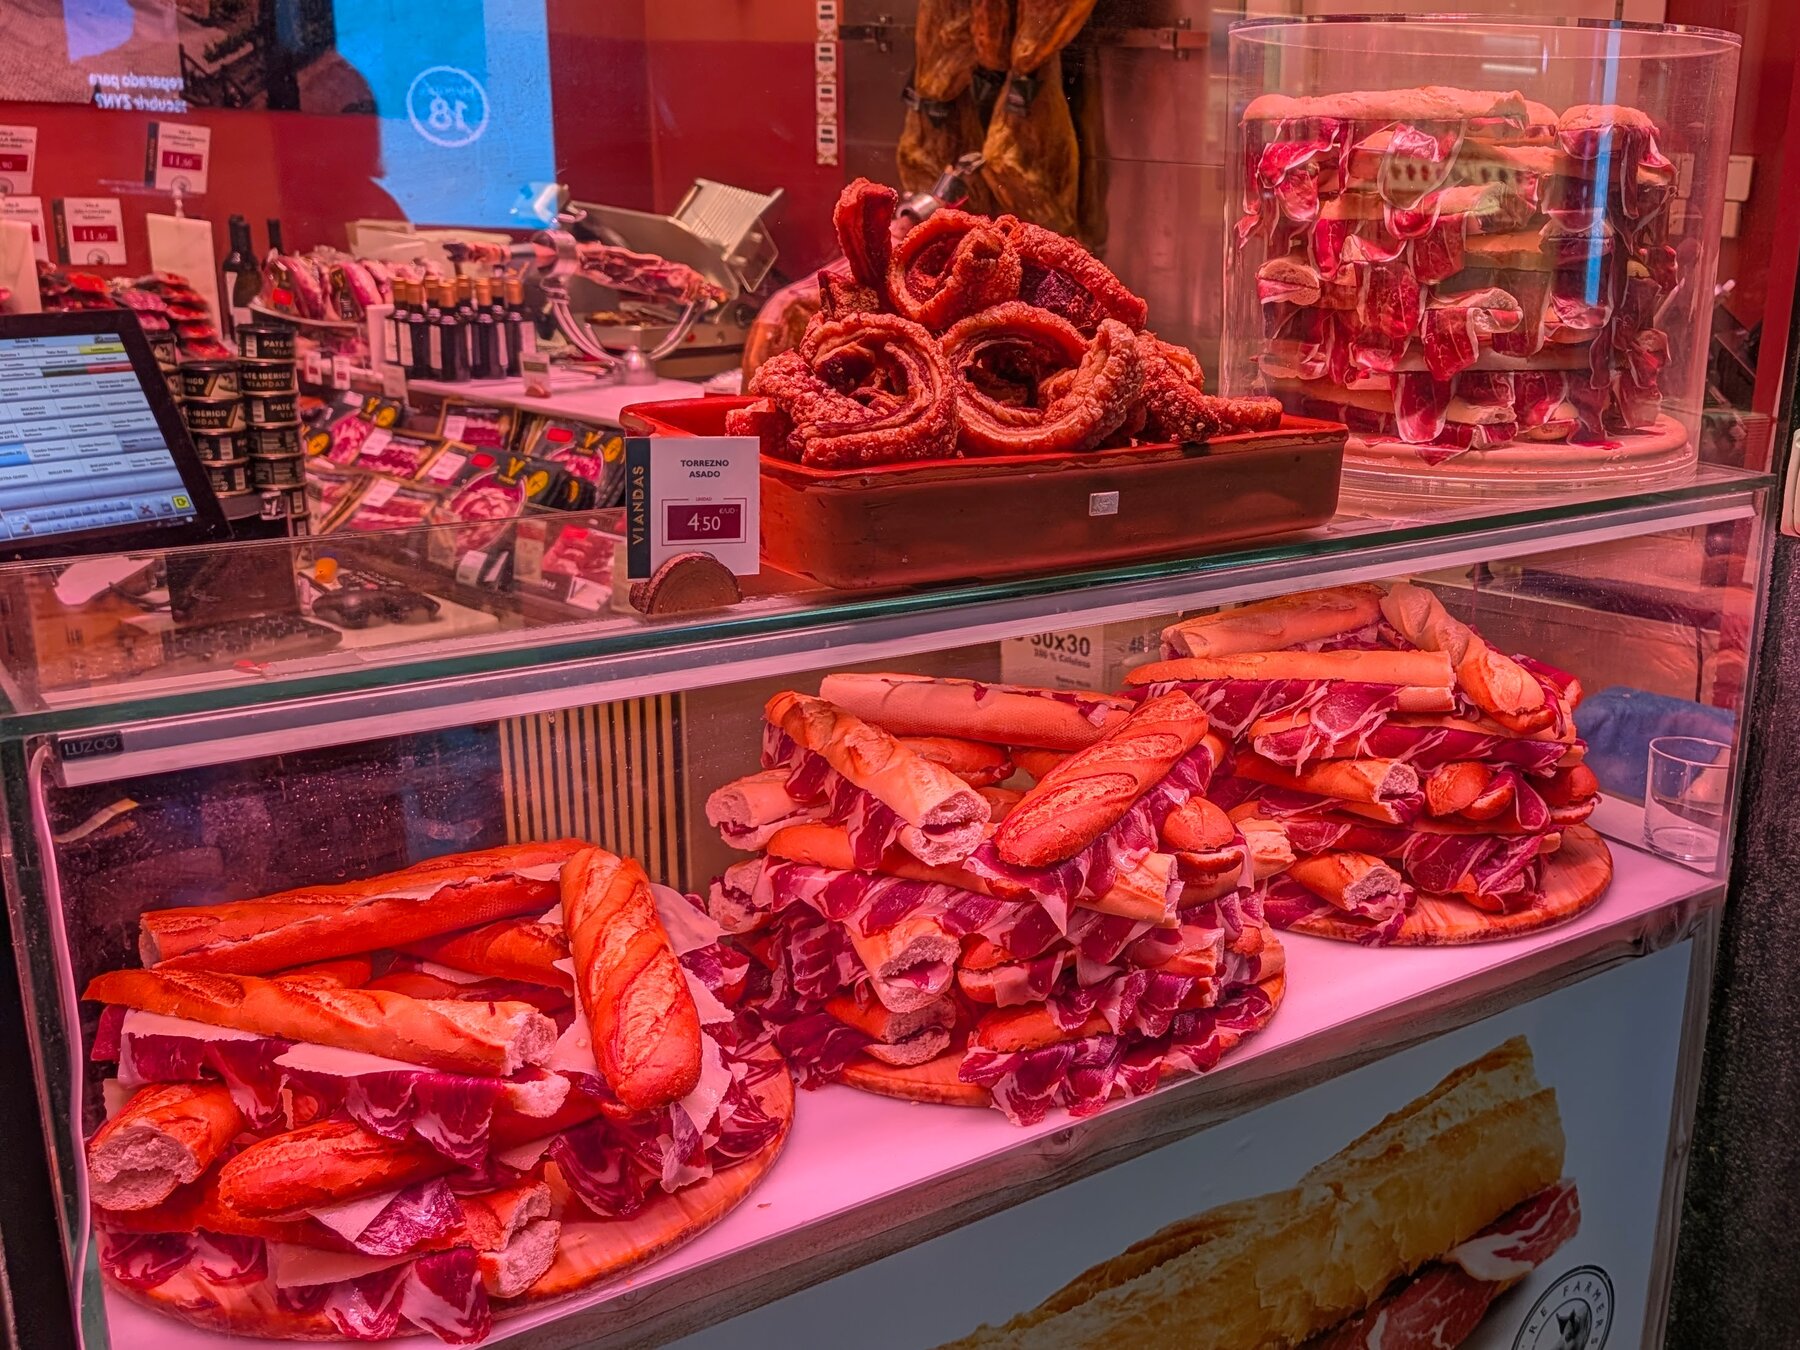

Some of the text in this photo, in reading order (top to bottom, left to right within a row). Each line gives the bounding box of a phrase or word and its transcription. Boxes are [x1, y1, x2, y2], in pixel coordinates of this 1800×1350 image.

[680, 459, 729, 467] TORREZNO
[689, 470, 721, 478] ASADO
[632, 465, 645, 545] VIANDAS
[64, 736, 118, 756] LUZCO
[1563, 1281, 1605, 1345] FARMERS
